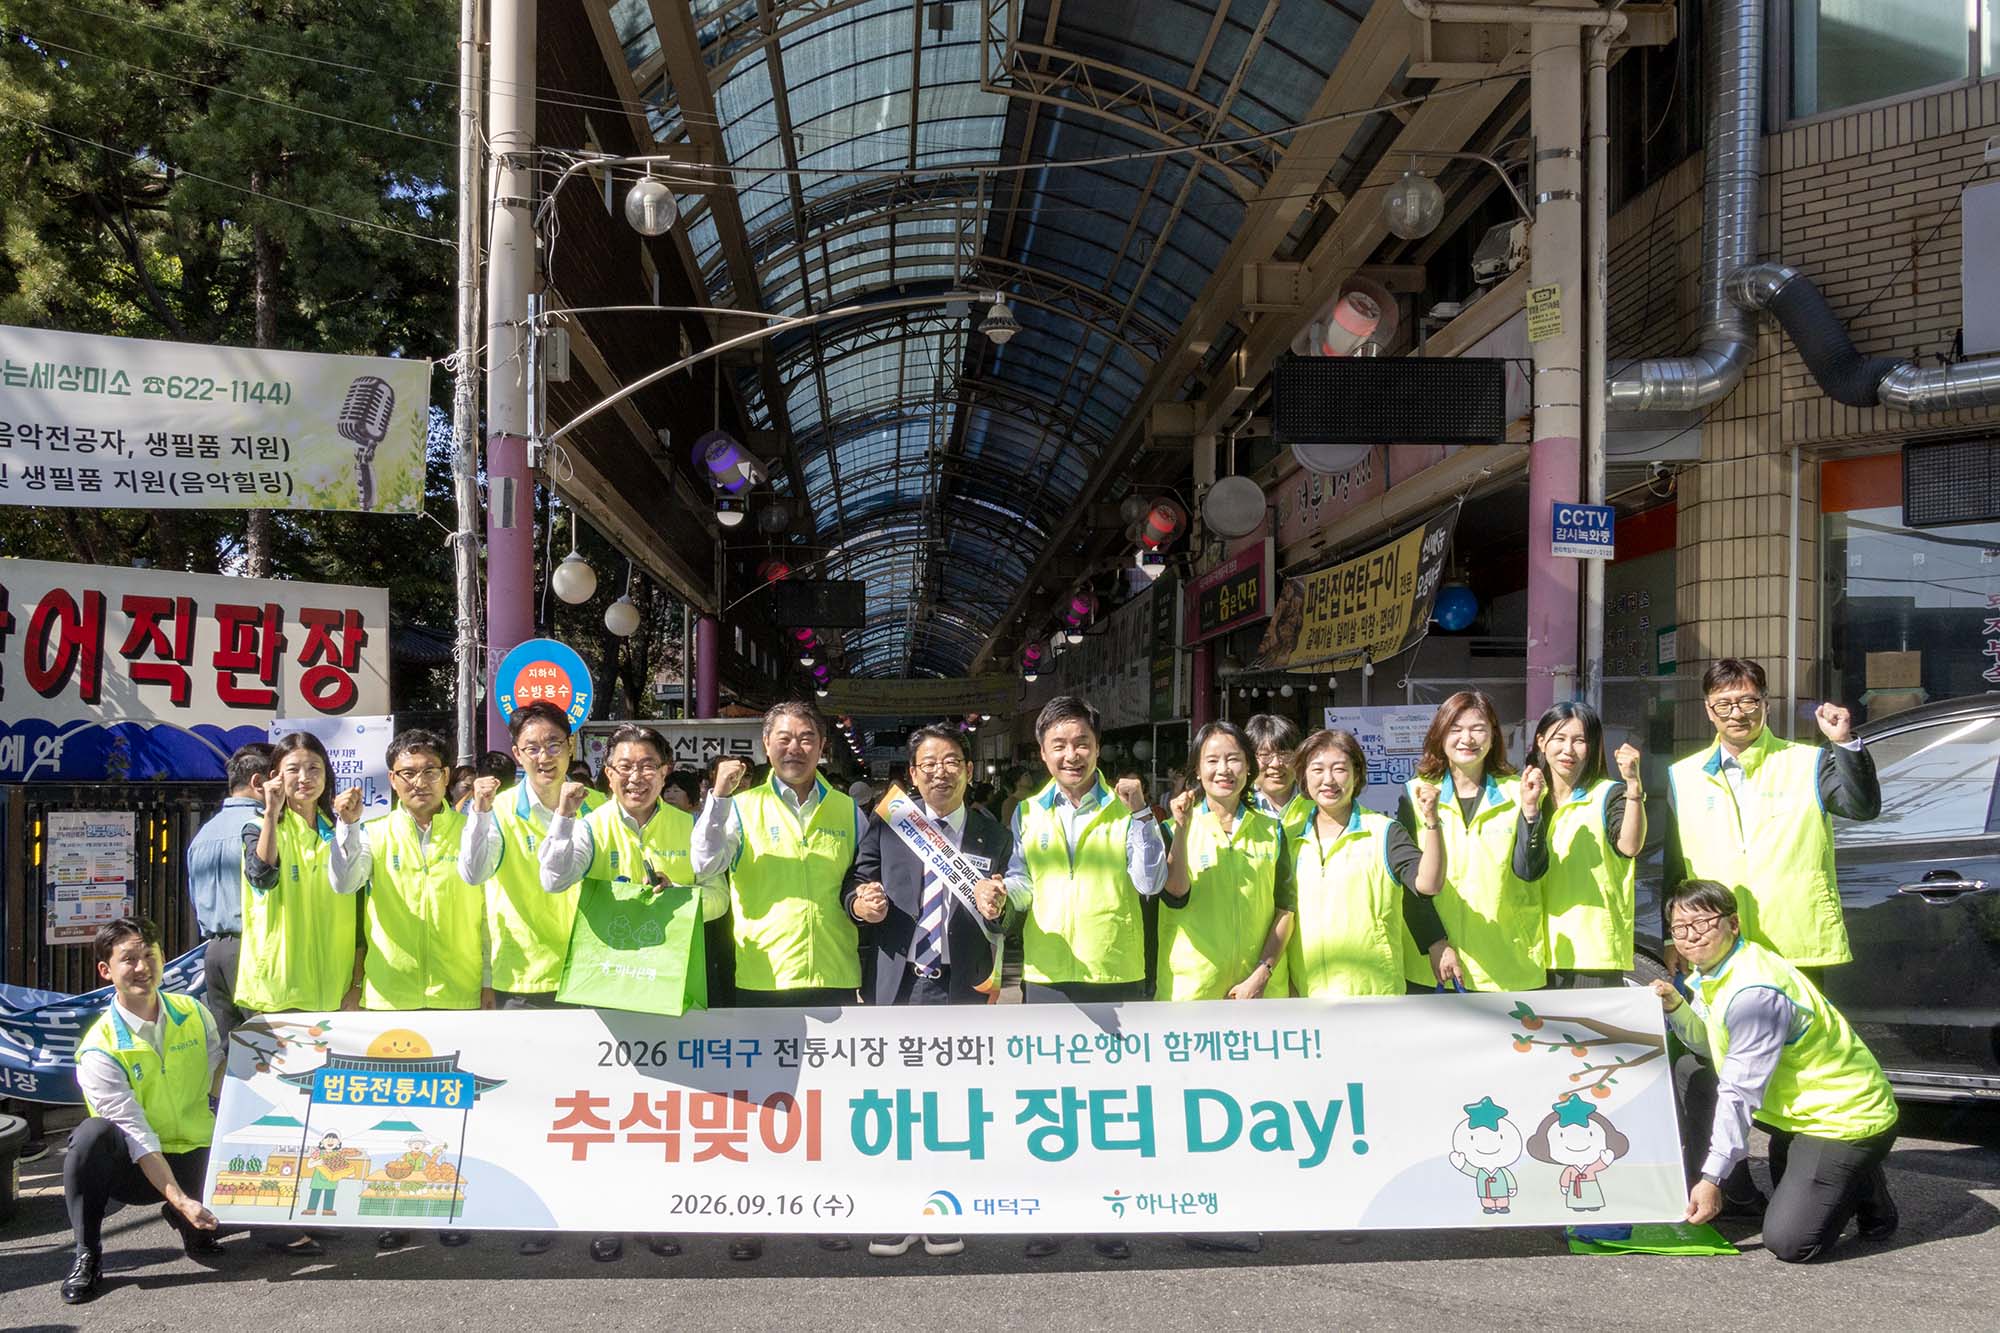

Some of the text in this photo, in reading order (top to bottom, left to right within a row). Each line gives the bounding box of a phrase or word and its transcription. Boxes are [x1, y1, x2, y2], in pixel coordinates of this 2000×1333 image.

[0, 359, 291, 405] 는세상미소 622-1144)
[145, 432, 221, 460] 생필품
[232, 436, 290, 462] 지원)
[21, 465, 102, 492] 생필품
[115, 470, 293, 496] 지원(음악힐링)
[1559, 508, 1608, 528] CCTV
[1556, 527, 1611, 543] 감시녹화중
[0, 582, 368, 715] 어직판장
[528, 667, 557, 678] 지하식
[517, 684, 570, 698] 소방용수
[1367, 758, 1417, 785] 급행
[597, 1029, 1322, 1068] 2026 대덕구 전통시장 활성화! 하나은행이 함께합니다!
[323, 1075, 464, 1105] 법동전통시장
[547, 1082, 1370, 1169] 추석맞이 하나 장터 Day!
[670, 1194, 855, 1218] 2026.09.16 (수)
[973, 1198, 1040, 1216] 대덕구
[1136, 1192, 1219, 1216] 하나은행
